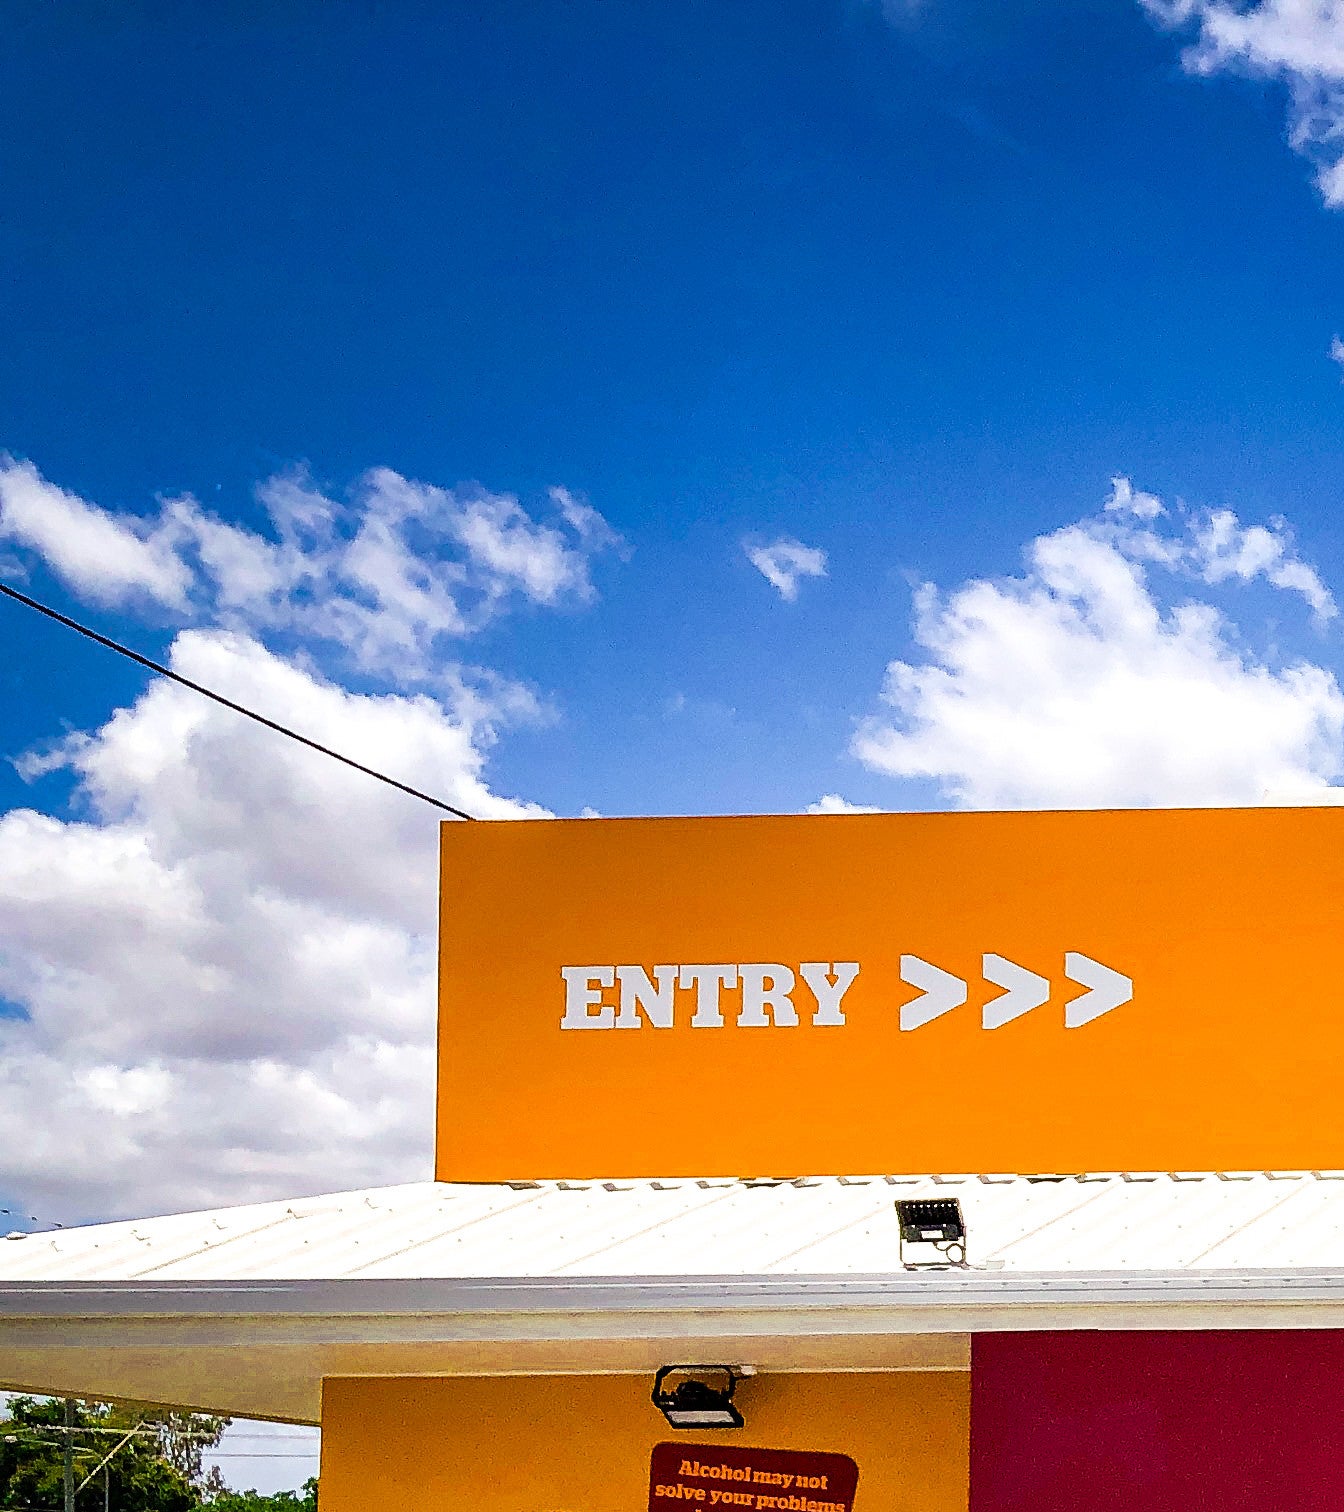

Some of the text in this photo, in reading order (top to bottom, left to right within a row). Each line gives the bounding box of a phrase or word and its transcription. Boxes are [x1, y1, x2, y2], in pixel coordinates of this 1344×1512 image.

[560, 963, 860, 1030] ENTRY
[679, 1459, 828, 1490] Alcohol may not
[655, 1483, 706, 1501] solve
[709, 1489, 755, 1505] your
